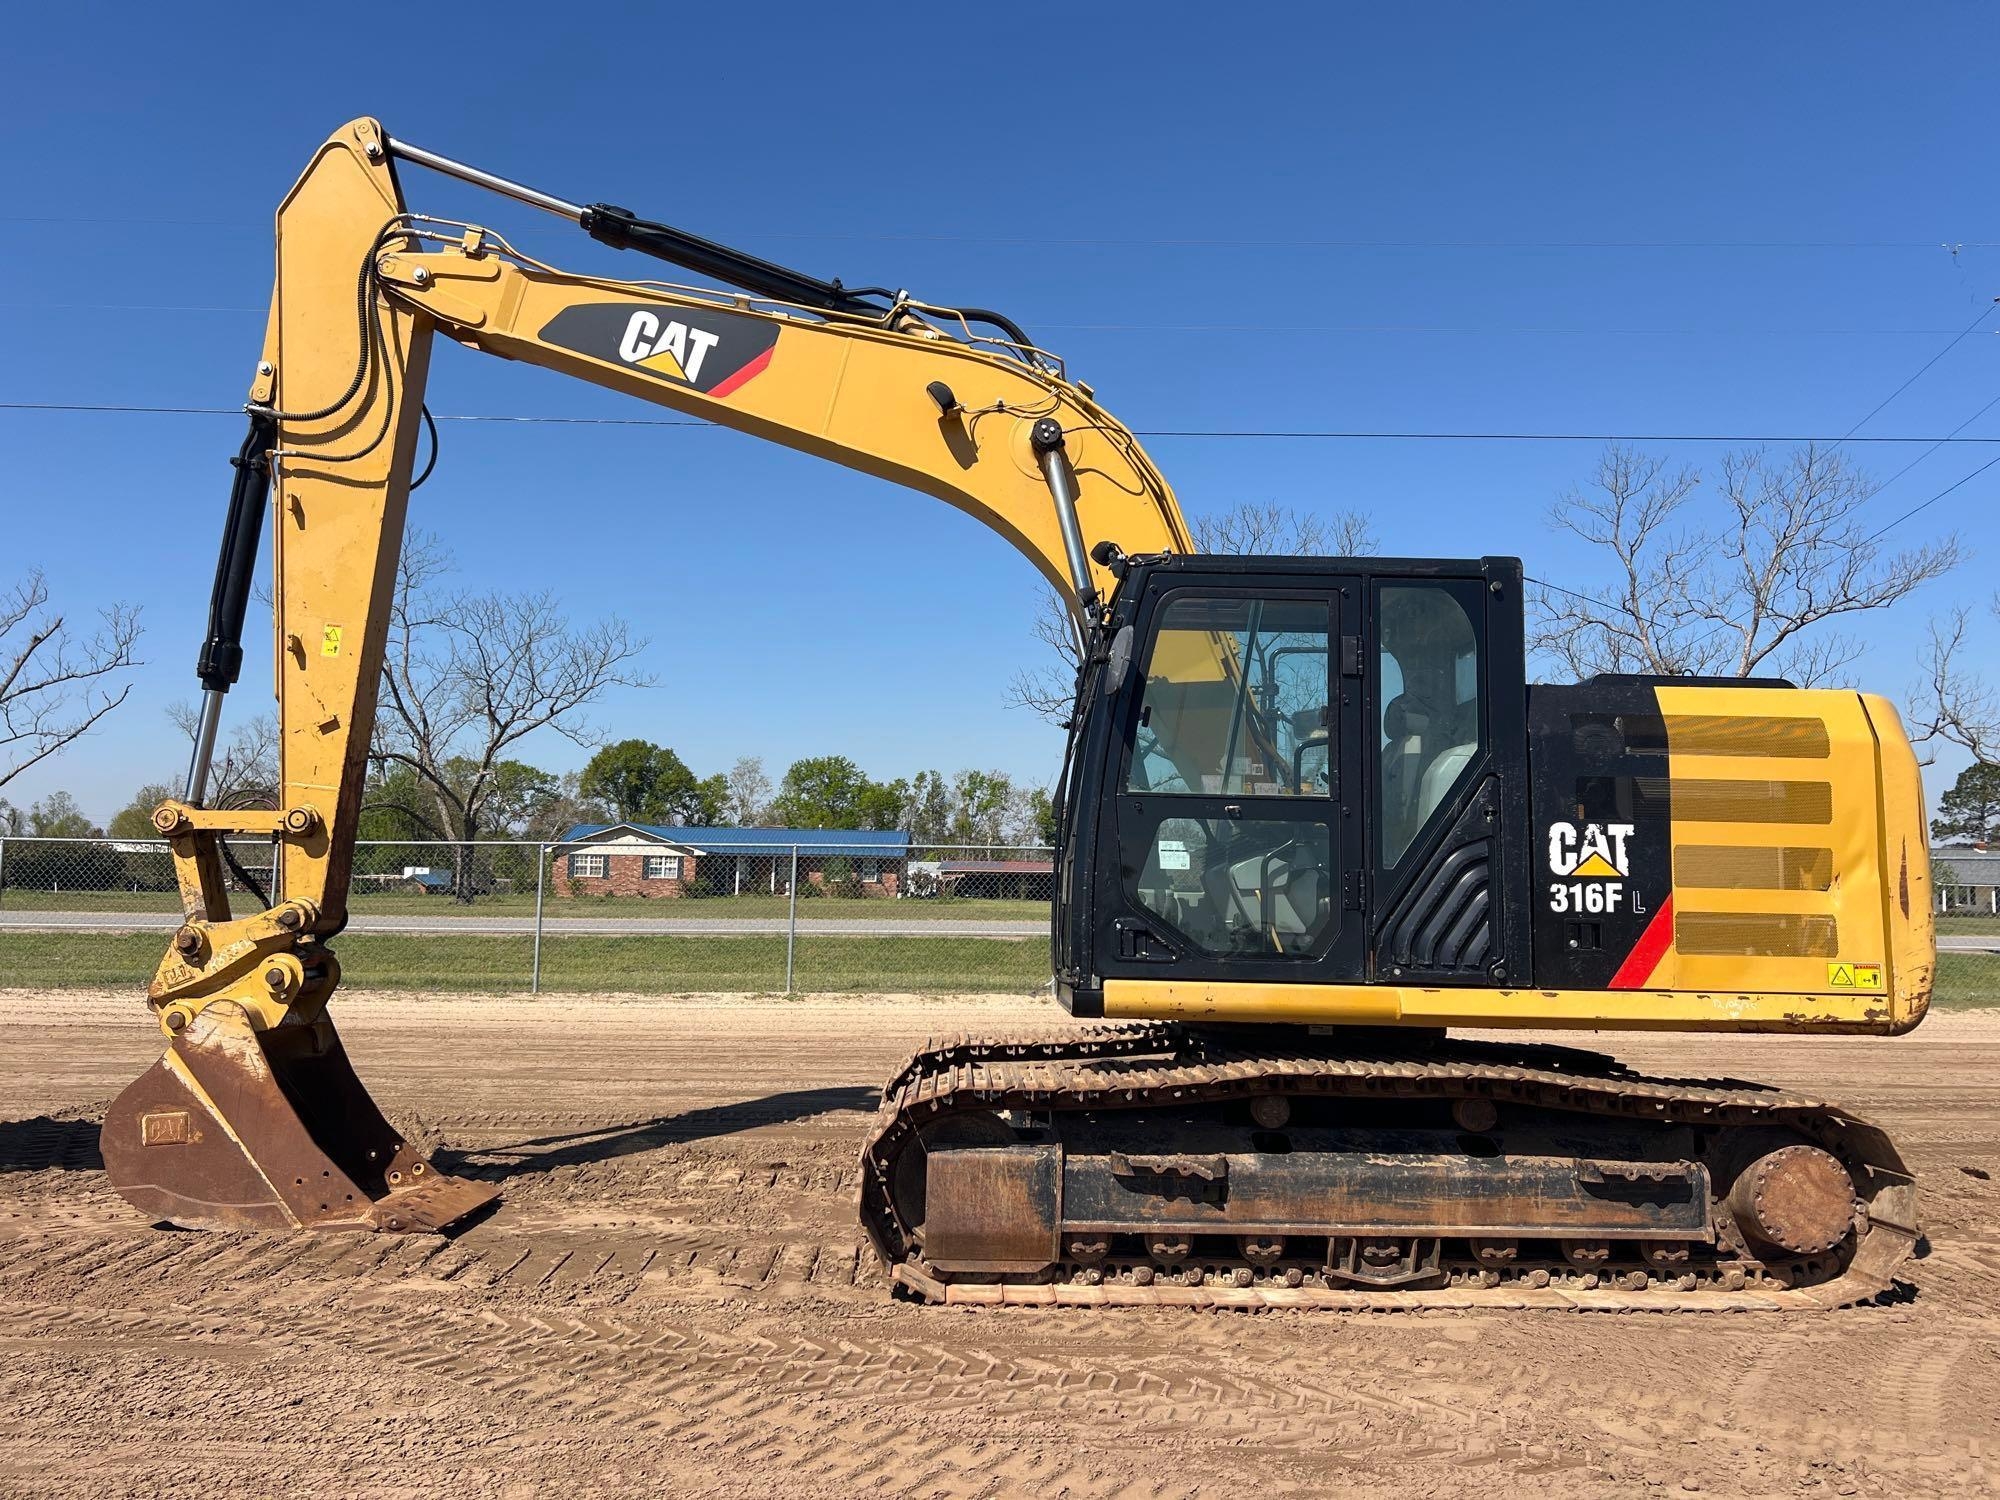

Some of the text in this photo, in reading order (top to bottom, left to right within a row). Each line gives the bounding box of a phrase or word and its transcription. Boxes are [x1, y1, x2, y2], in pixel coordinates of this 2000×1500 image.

[619, 310, 720, 383] CAT
[1549, 821, 1635, 877] CAT
[1550, 882, 1623, 913] 316F
